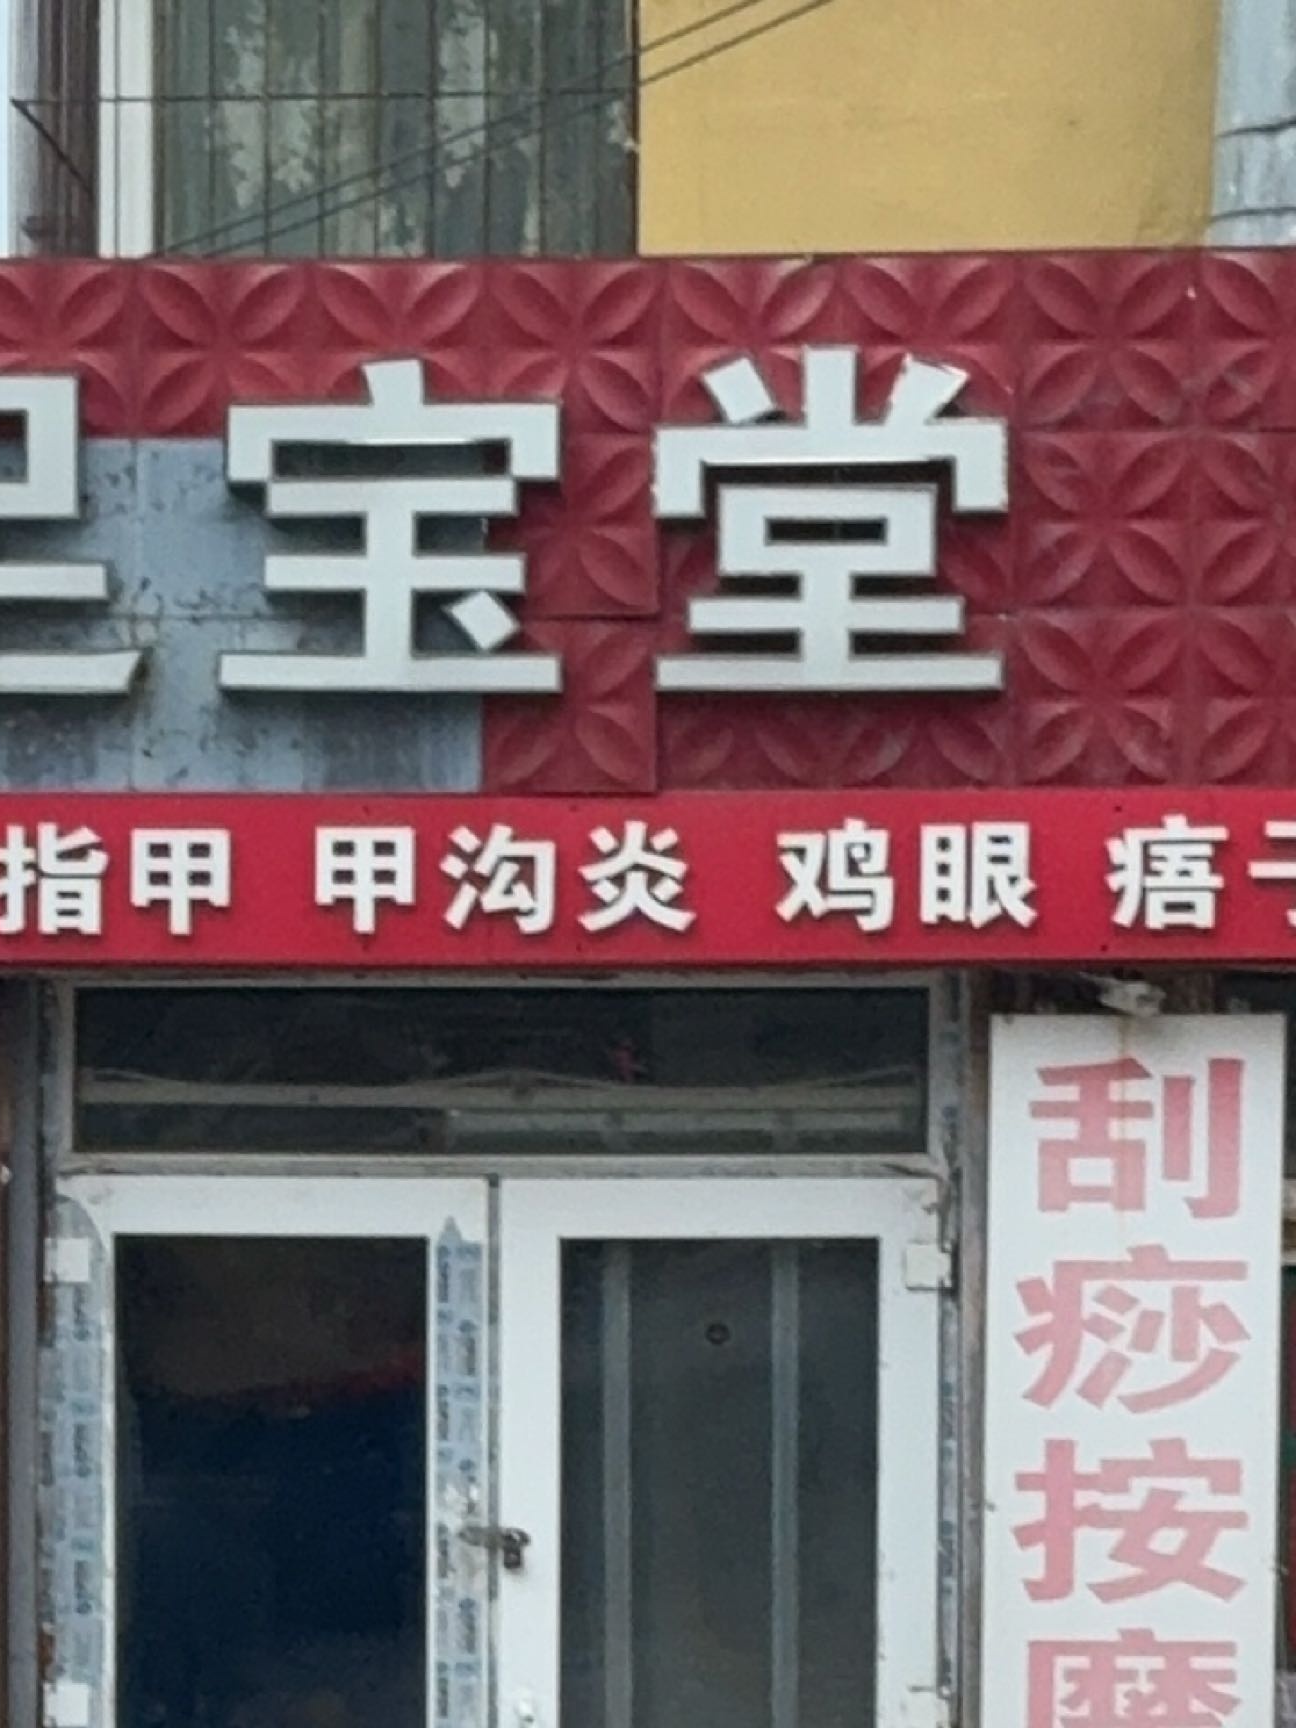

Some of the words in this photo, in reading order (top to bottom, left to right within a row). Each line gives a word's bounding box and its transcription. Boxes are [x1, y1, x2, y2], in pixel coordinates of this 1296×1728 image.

[316, 824, 695, 935] 甲沟炎
[776, 820, 1039, 932] 鸡眼
